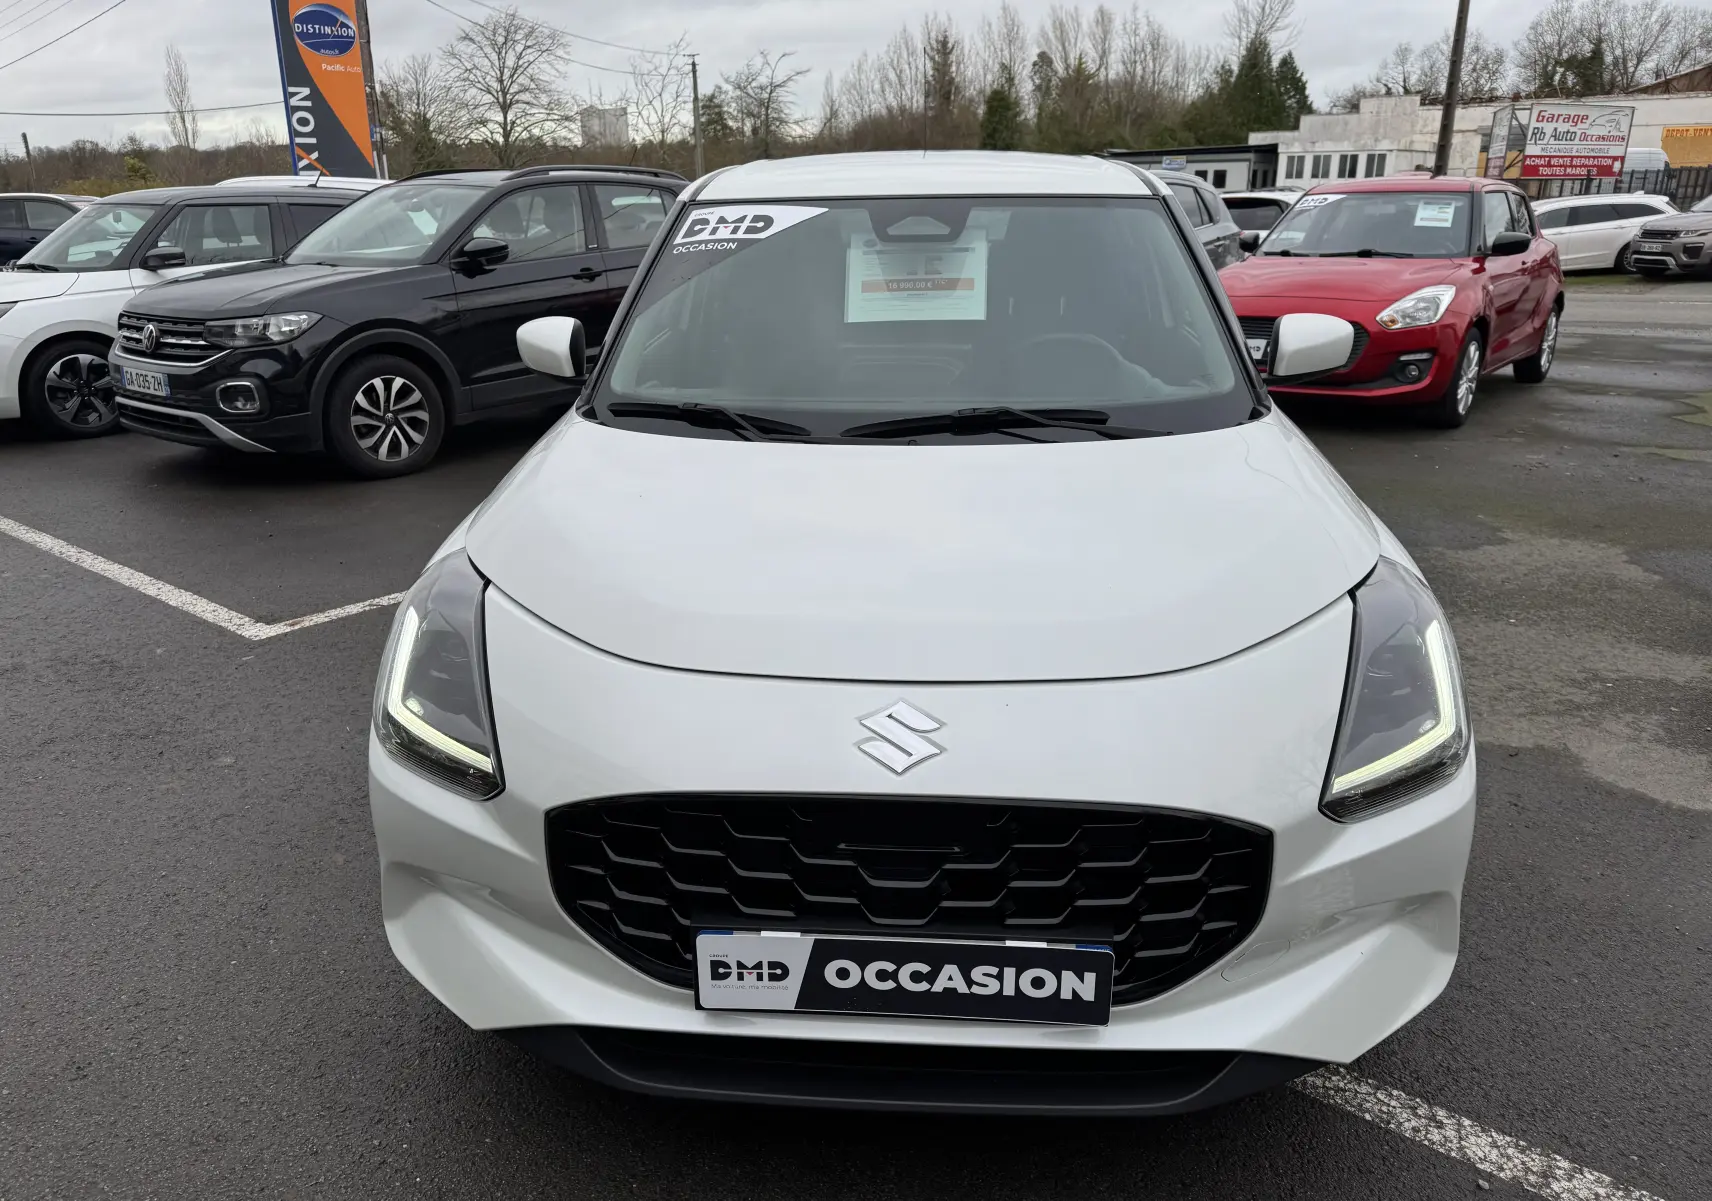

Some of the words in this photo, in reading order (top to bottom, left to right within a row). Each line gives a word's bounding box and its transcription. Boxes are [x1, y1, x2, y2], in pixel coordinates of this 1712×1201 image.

[294, 23, 355, 37] DISTINXION
[321, 63, 345, 72] Pacific
[1536, 109, 1589, 127] Garage
[287, 86, 319, 176] XION
[1529, 126, 1546, 146] Rb
[1546, 127, 1577, 145] Auto
[1578, 131, 1626, 143] Occasions
[1540, 146, 1574, 155] MECANIQUE
[1575, 147, 1611, 155] AUTOMOBILE
[1525, 157, 1549, 166] ACHAT
[1550, 158, 1572, 166] VENTE
[1573, 158, 1613, 167] REPARATION
[1539, 167, 1565, 175] TOUTES
[680, 214, 775, 240] DMD
[673, 241, 738, 254] OCCASION
[125, 370, 163, 393] GA-035-ZH
[709, 959, 790, 982] DMD
[823, 958, 1098, 1002] OCCASION
